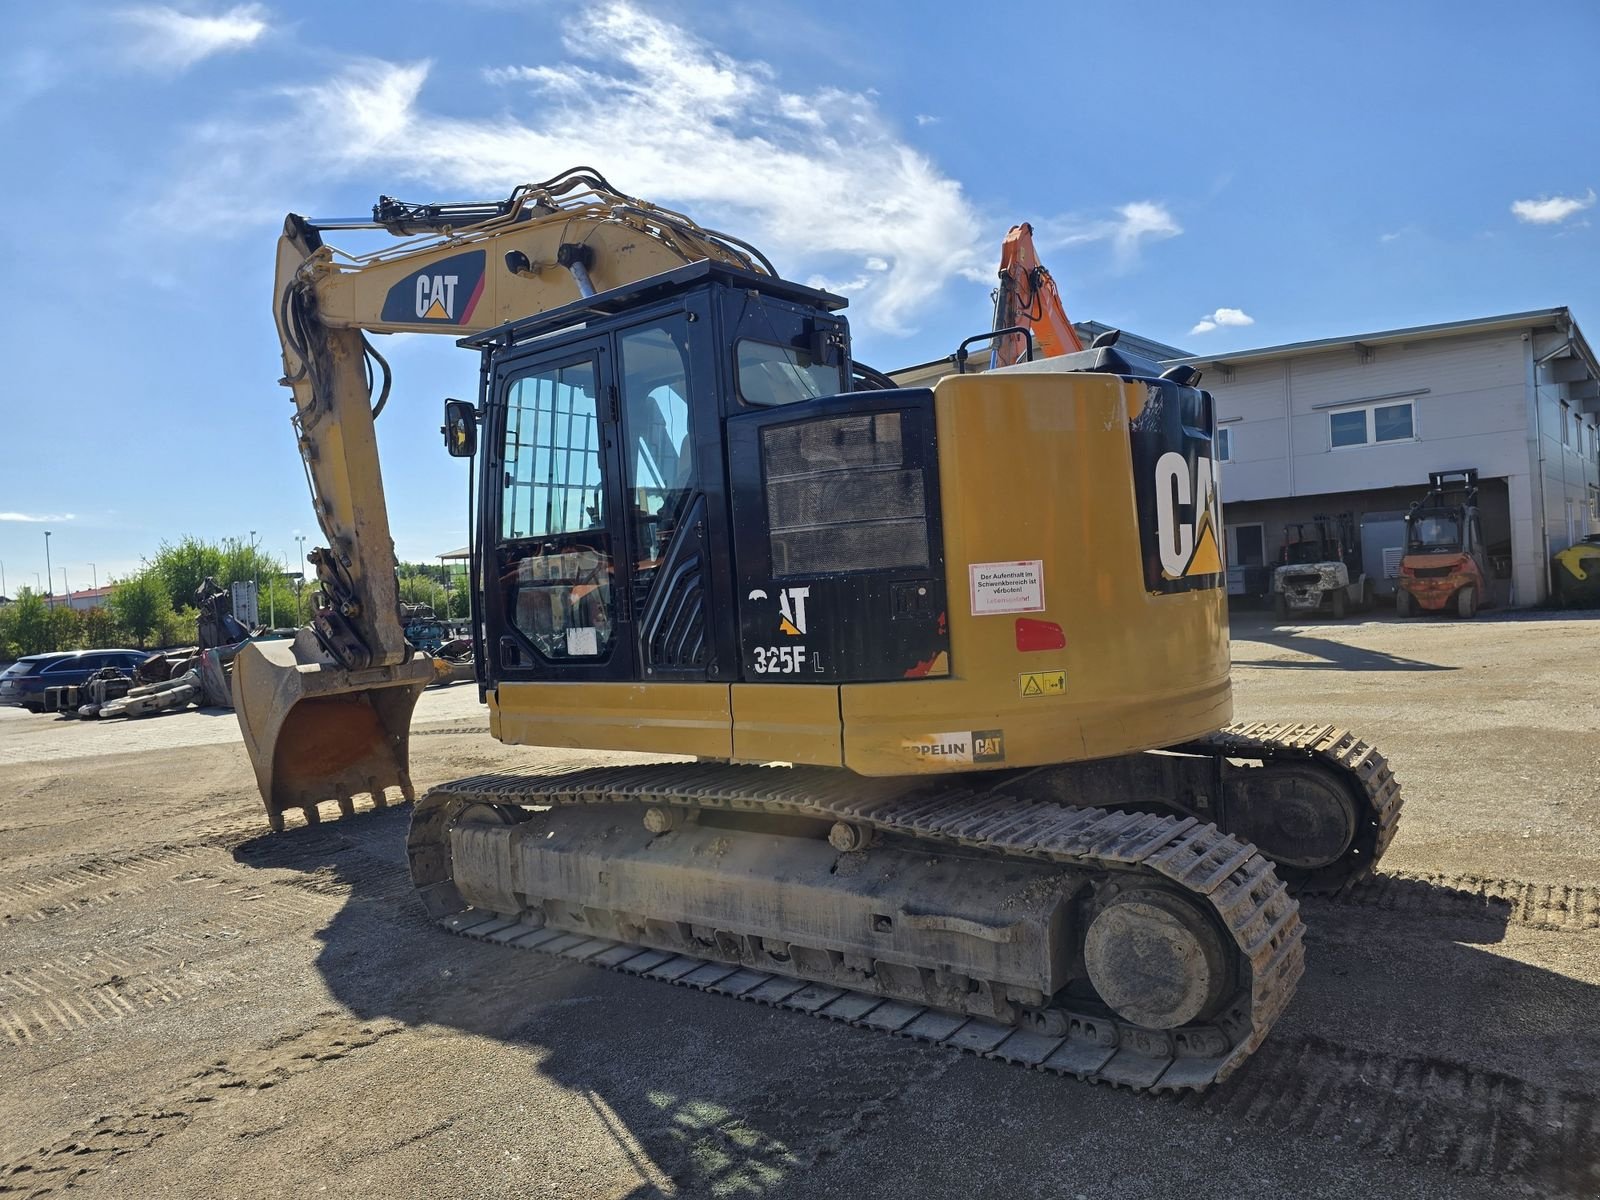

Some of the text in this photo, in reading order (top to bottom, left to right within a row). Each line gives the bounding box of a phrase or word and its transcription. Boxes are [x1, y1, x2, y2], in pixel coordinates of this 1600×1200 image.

[416, 274, 458, 319] CAT
[977, 579, 1028, 587] Schwenkbereich
[748, 586, 810, 634] AT
[753, 646, 824, 673] 325F L
[975, 737, 1001, 756] CAT
